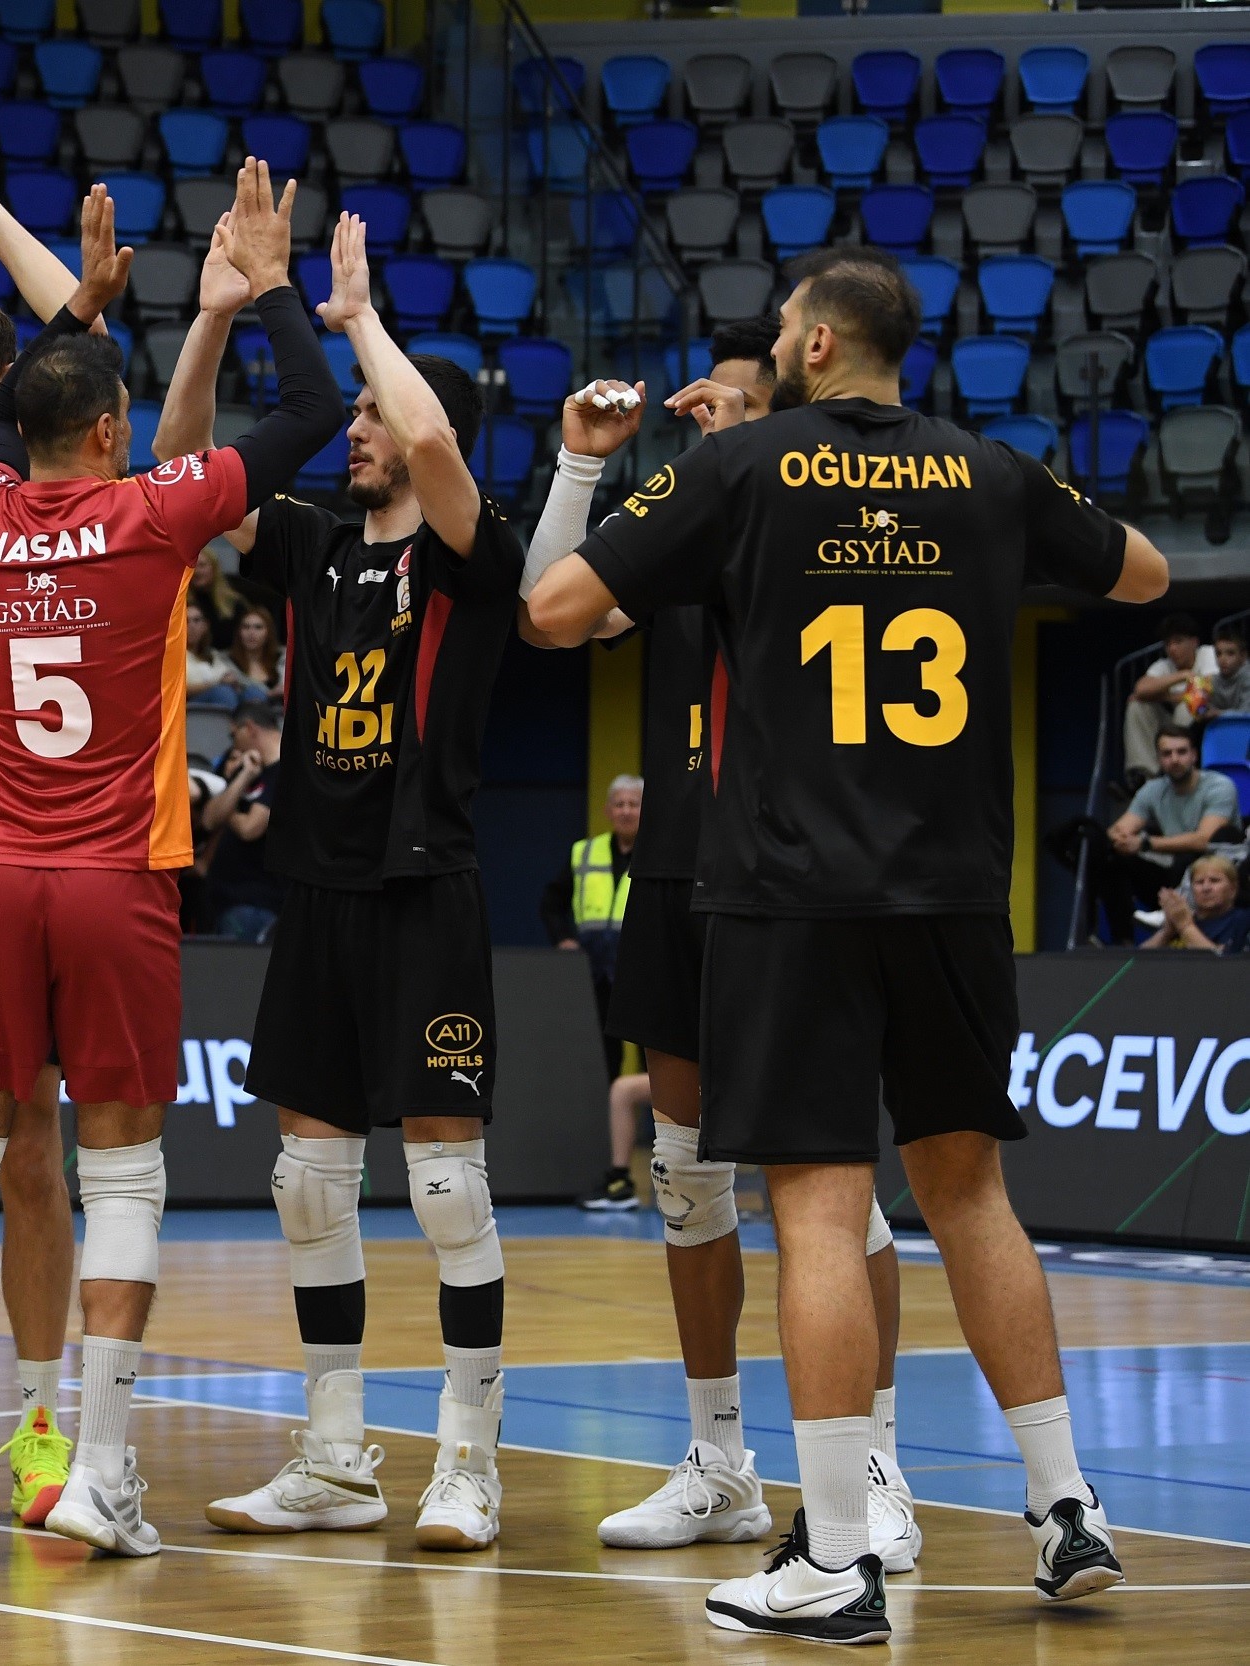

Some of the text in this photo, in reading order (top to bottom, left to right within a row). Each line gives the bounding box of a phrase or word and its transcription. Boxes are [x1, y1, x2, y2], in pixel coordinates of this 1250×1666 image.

[779, 443, 972, 489] OĞUZHAN
[622, 496, 649, 518] ELS
[817, 535, 941, 565] GSYİAD
[800, 604, 969, 747] 13
[8, 635, 93, 759] 5
[314, 700, 395, 751] HDI
[314, 749, 394, 772] SİGORTA
[435, 1023, 471, 1042] A11
[426, 1054, 484, 1068] HOTELS
